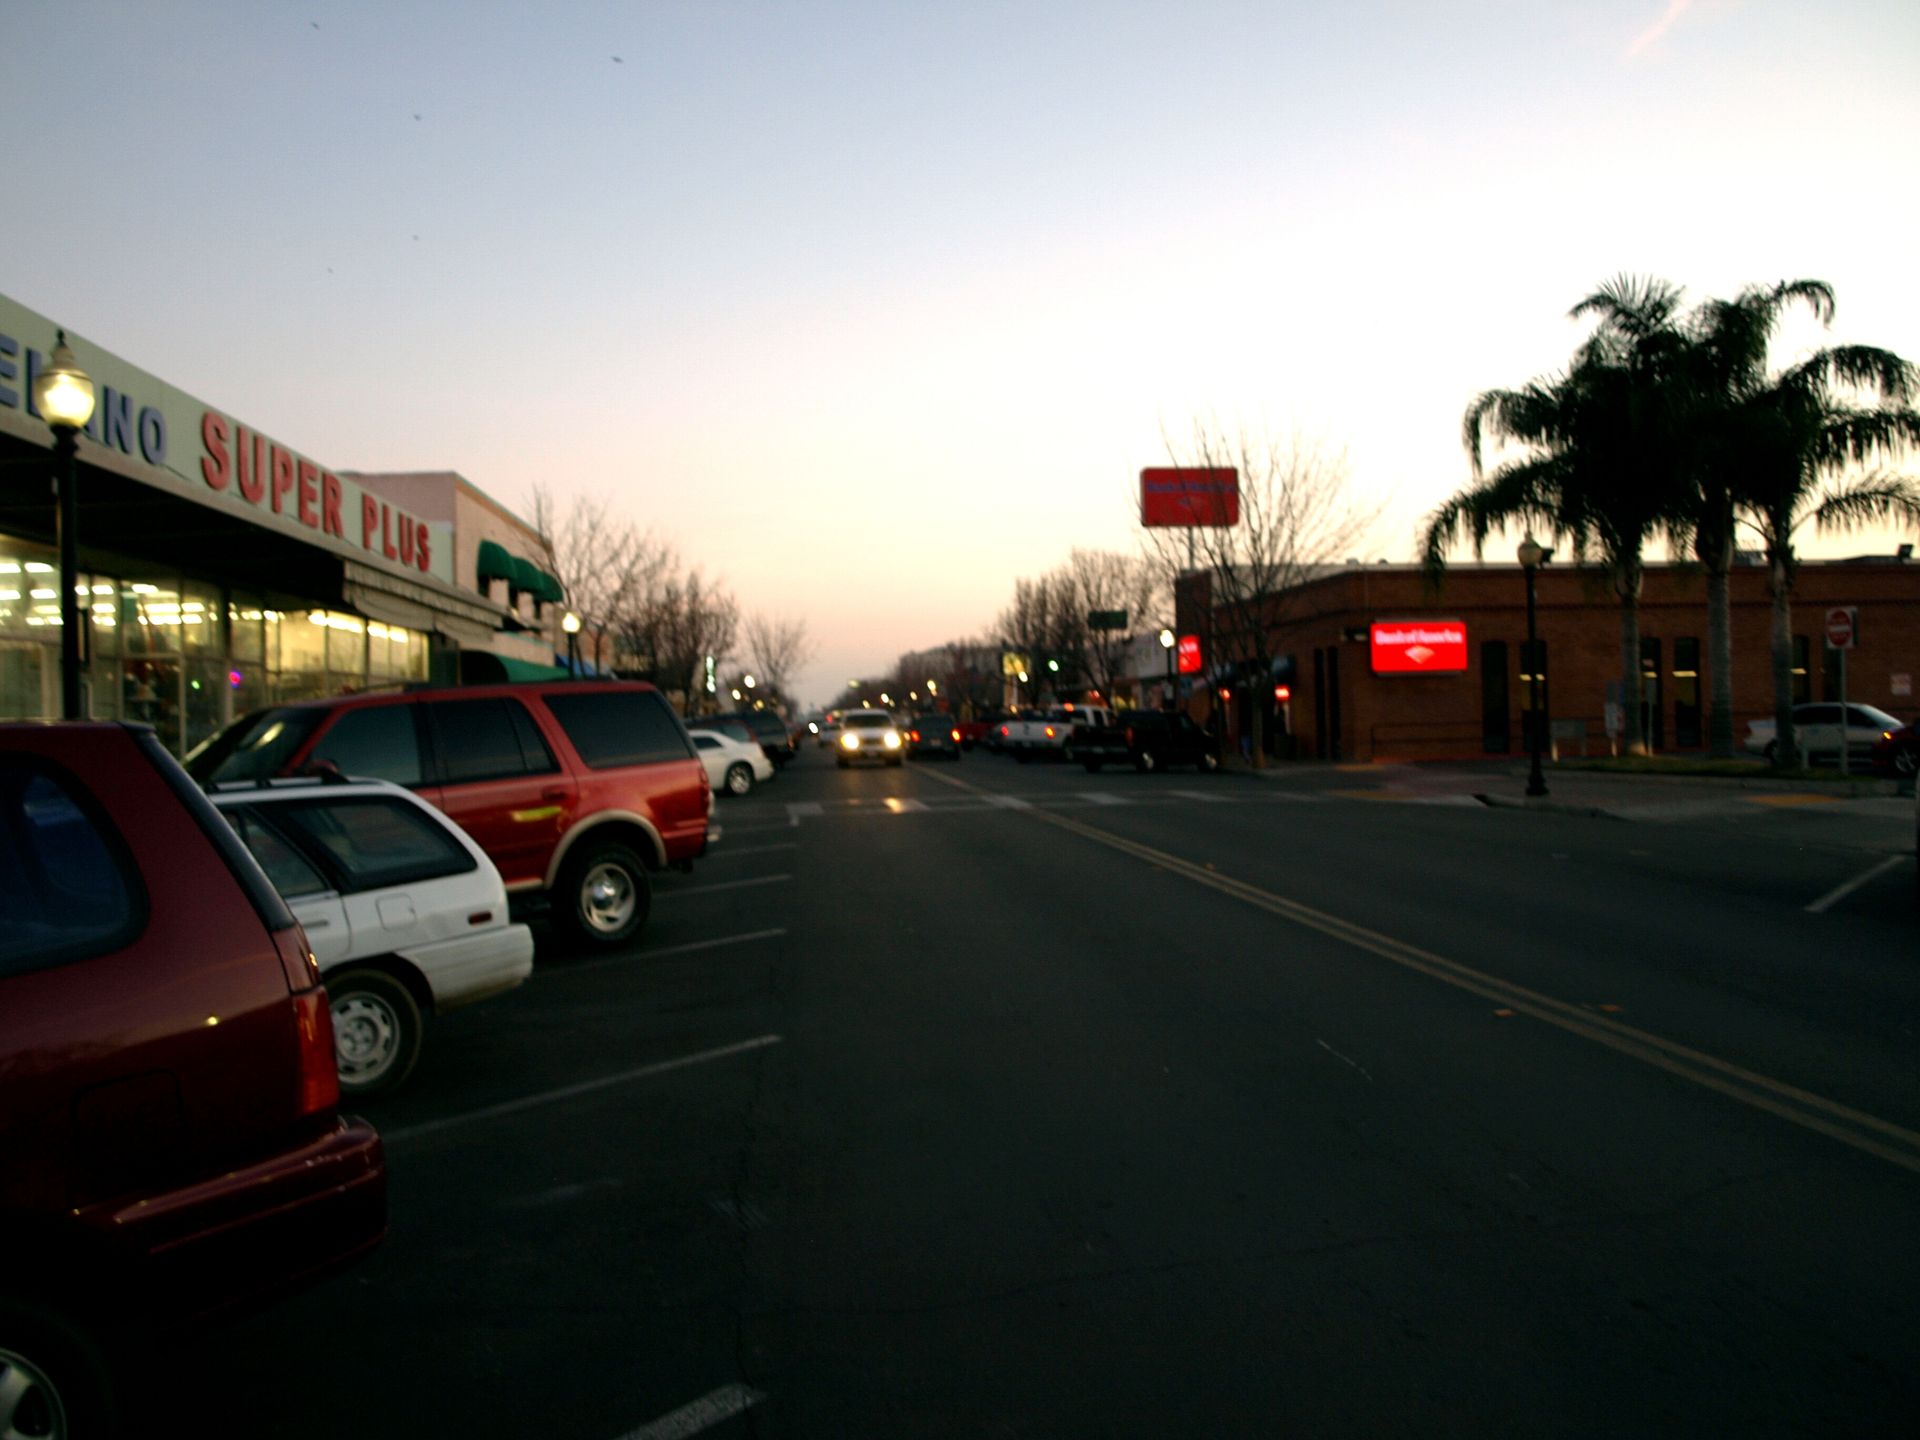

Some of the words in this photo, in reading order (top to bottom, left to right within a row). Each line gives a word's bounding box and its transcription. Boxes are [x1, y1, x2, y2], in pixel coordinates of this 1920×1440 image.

[0, 335, 166, 464] ELNO
[201, 411, 344, 538] SUPER
[361, 494, 430, 572] PLUS
